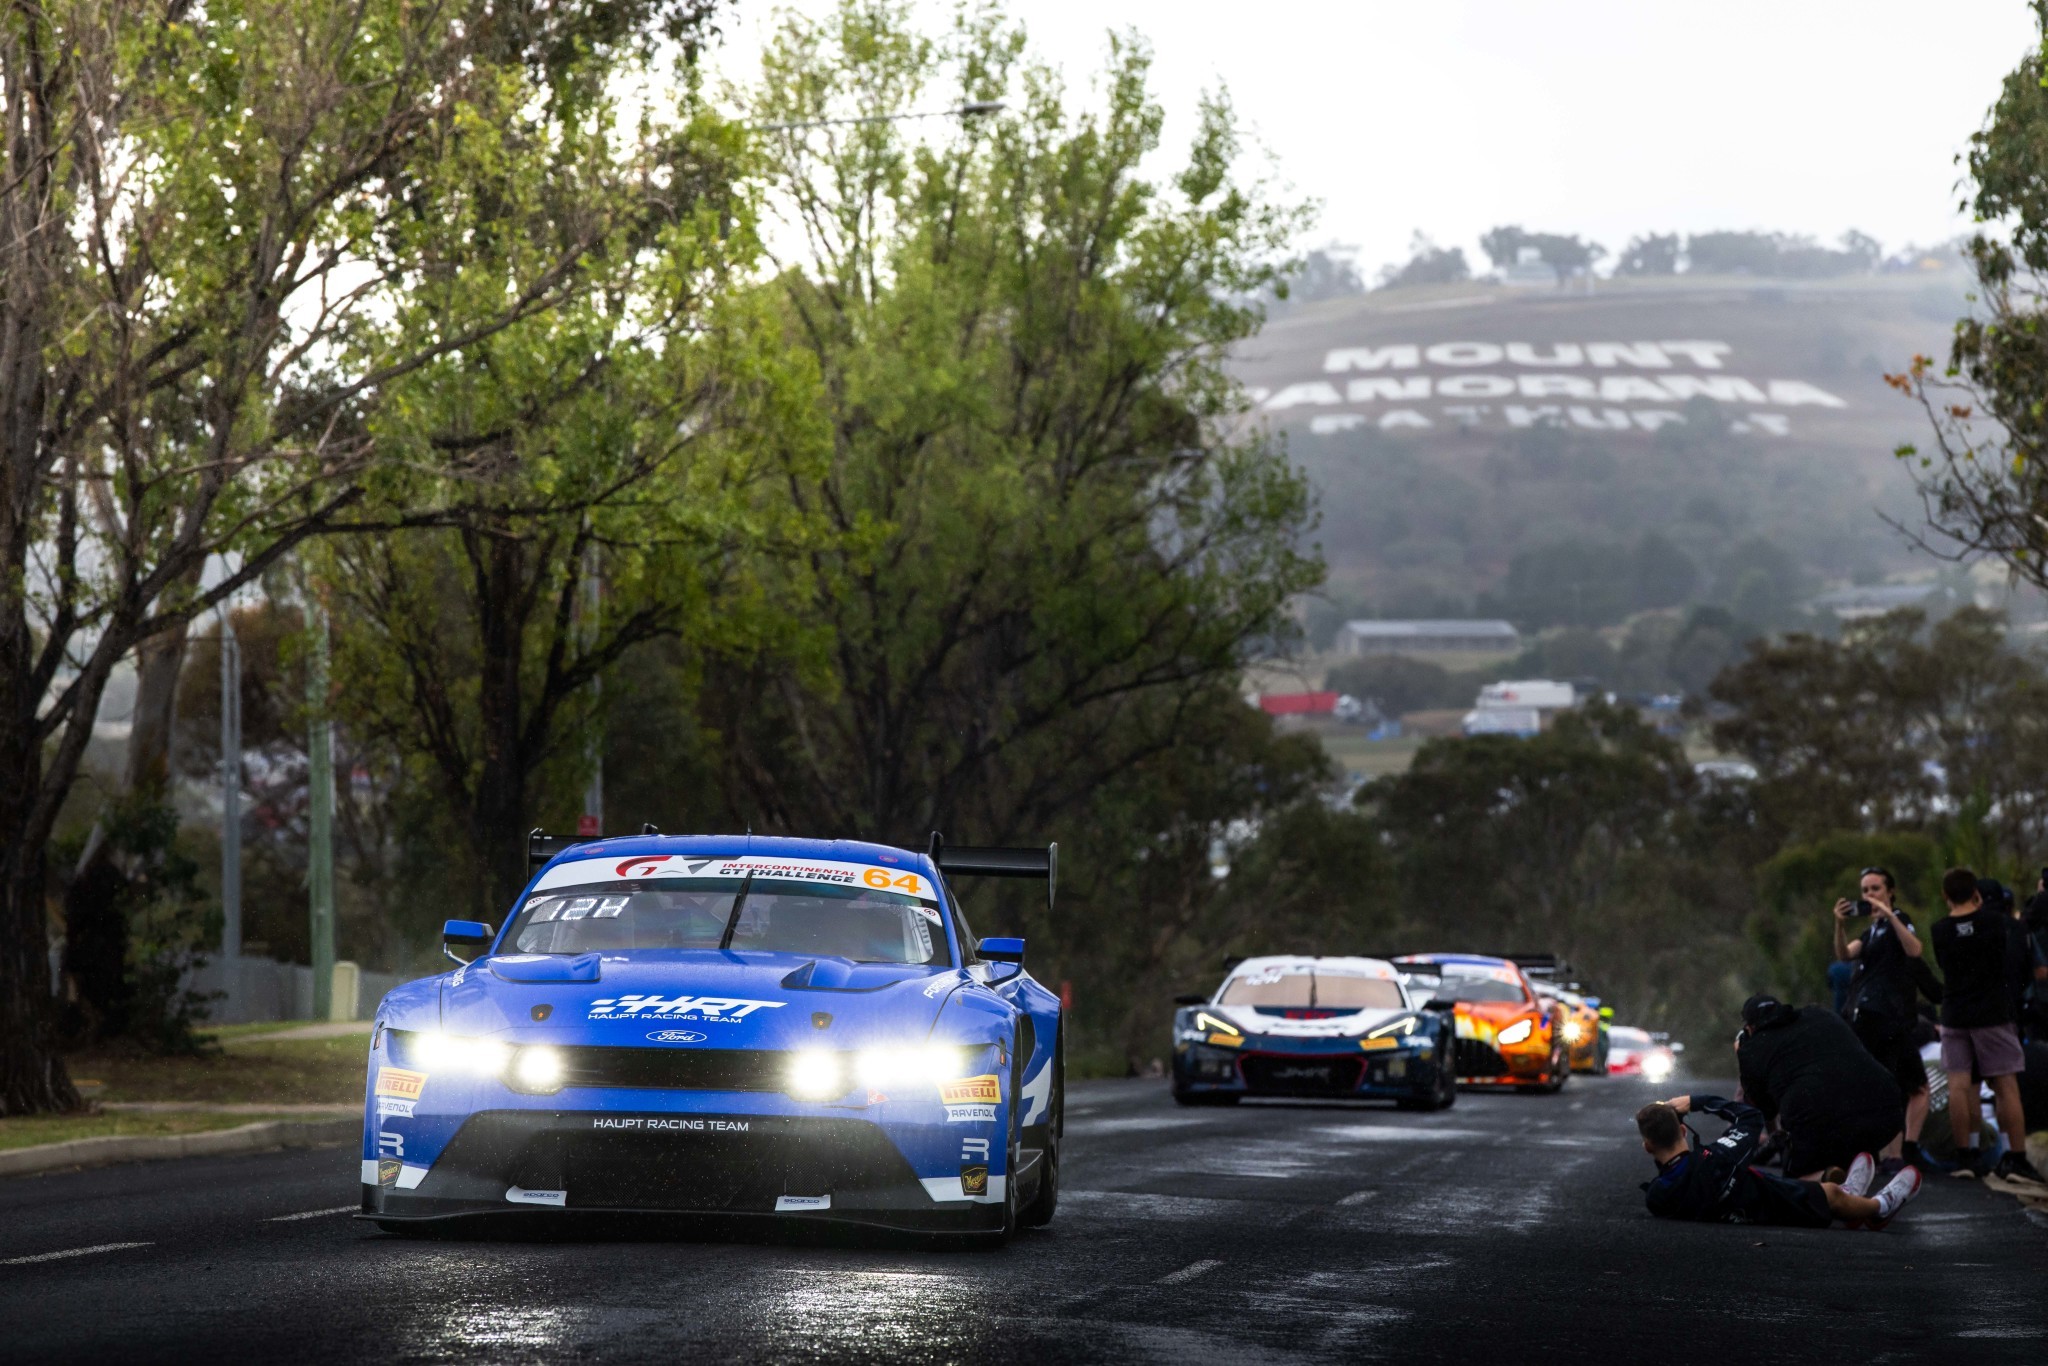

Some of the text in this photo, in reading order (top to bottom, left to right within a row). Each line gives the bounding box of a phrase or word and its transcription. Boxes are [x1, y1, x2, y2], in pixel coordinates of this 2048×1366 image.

[1323, 341, 1733, 374] MOUNT
[718, 868, 856, 883] GT CHALLENGE
[722, 863, 857, 877] INTERCONTINENTAL
[863, 868, 922, 894] 64
[549, 897, 630, 920] 12H
[641, 1013, 698, 1021] RACING
[702, 1015, 743, 1024] TEAM
[657, 1030, 696, 1042] Ford
[943, 1080, 996, 1098] PIRELLI
[951, 1108, 993, 1118] RAVENOL
[593, 1119, 749, 1131] HAUPT RACING TEAM
